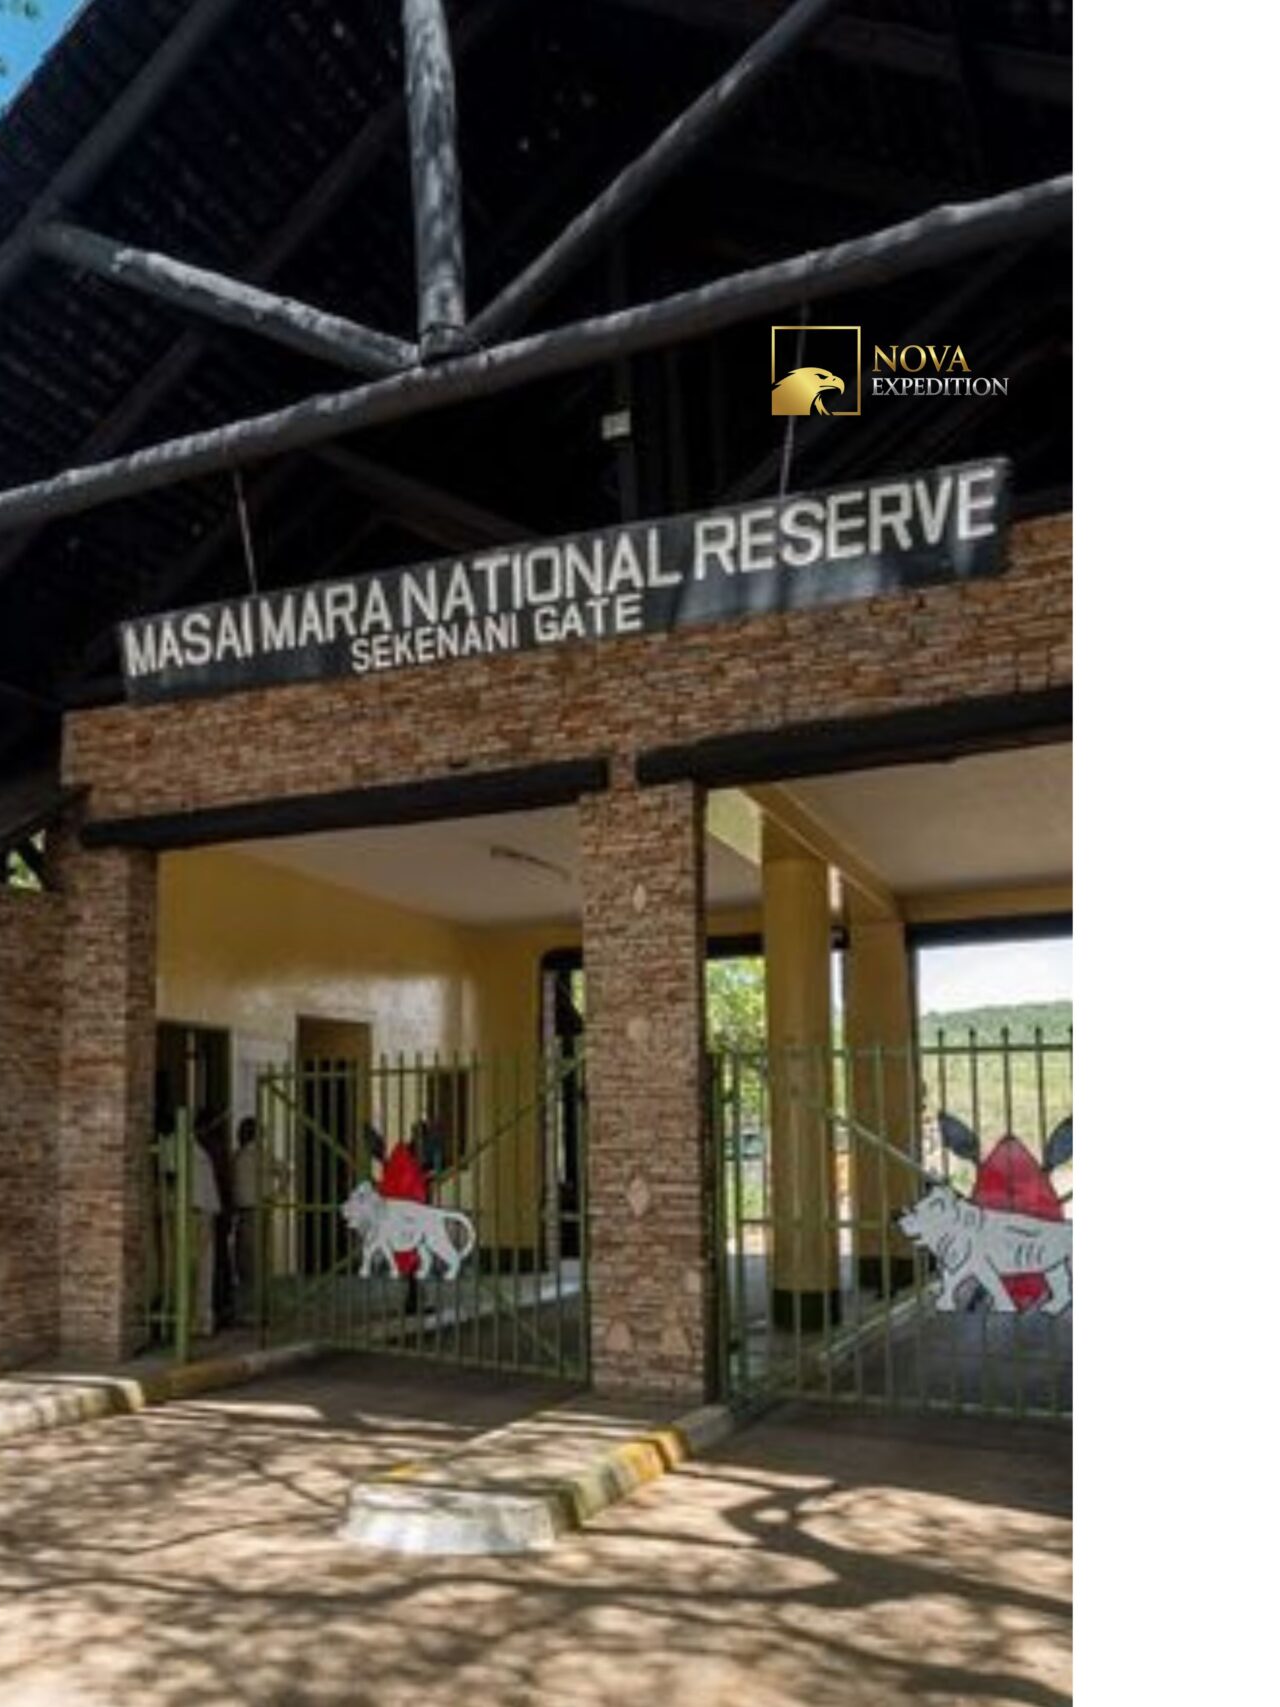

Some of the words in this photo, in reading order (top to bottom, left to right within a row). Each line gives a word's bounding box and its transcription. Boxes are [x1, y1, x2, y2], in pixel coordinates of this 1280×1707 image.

[124, 599, 254, 678] MASAI
[258, 577, 393, 653] MARA
[400, 527, 683, 628] NATIONAL
[693, 466, 996, 581] RESERVE
[350, 611, 518, 673] SEKENANI
[534, 592, 644, 643] GATE
